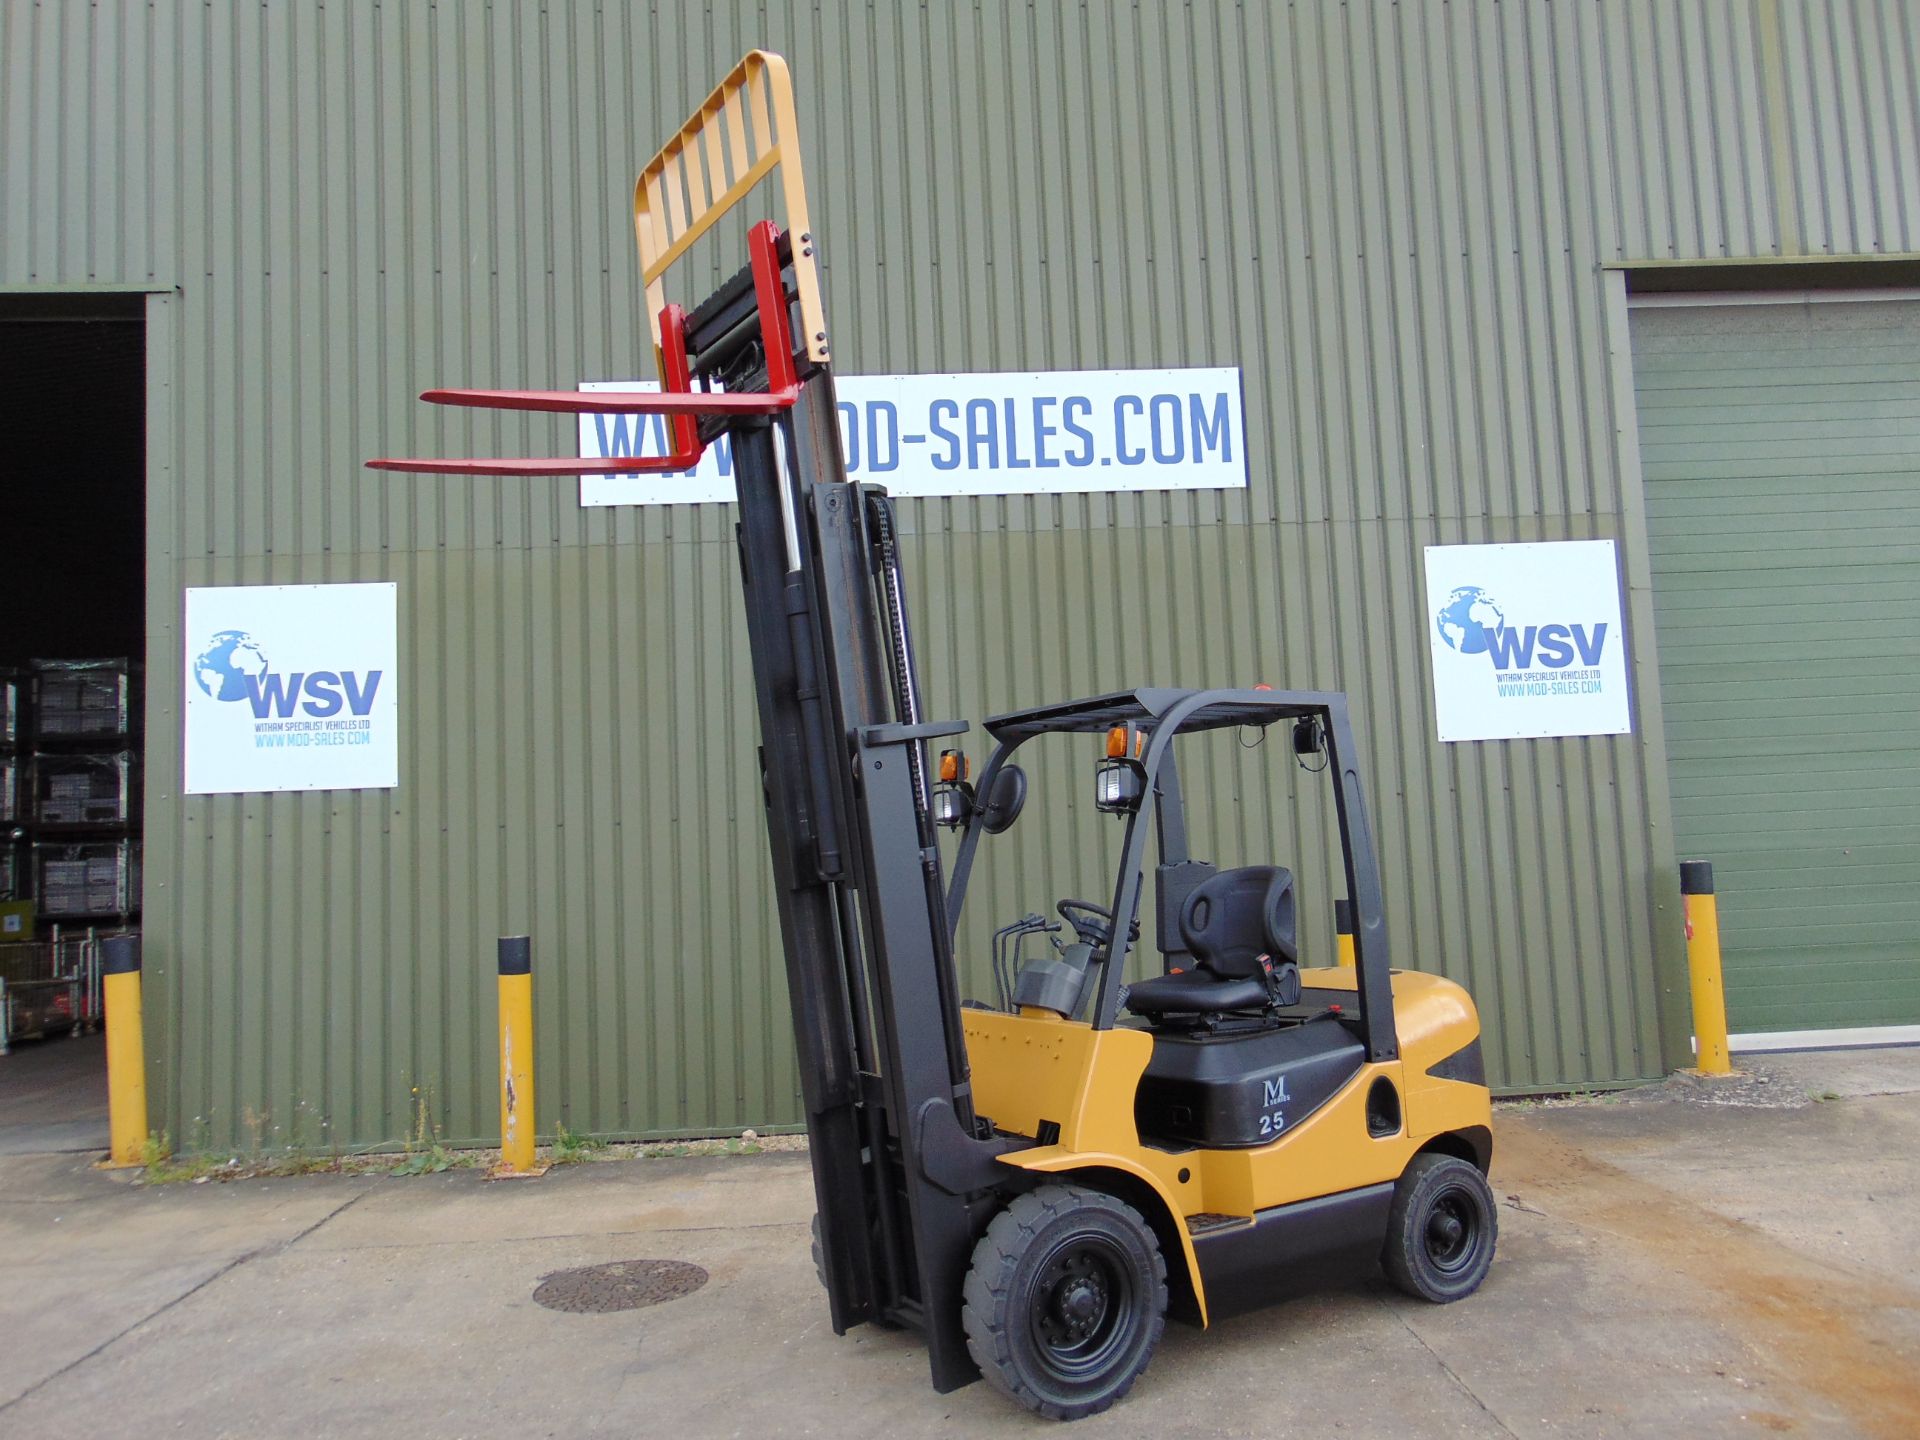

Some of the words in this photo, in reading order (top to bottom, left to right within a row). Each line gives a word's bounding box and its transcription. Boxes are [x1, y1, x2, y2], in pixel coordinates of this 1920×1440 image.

[594, 393, 1232, 480] WOD-SALES.COM
[1482, 622, 1608, 670] WSV
[1496, 673, 1522, 683] WITHAM
[1524, 671, 1558, 682] SPECIALIST
[1560, 670, 1588, 680] VEHICLES
[1590, 669, 1600, 679] LTD
[1497, 680, 1602, 697] WWWMOD-SALESCOM
[244, 670, 383, 719] WSV
[255, 722, 283, 732] WITHAM
[285, 721, 323, 731] SPECIALIST
[326, 720, 357, 730] VEHICLES
[359, 719, 370, 729] LTD
[255, 731, 370, 748] WWWMOD-SALESCOM
[1262, 1075, 1285, 1108] M
[1259, 1110, 1284, 1135] 25
